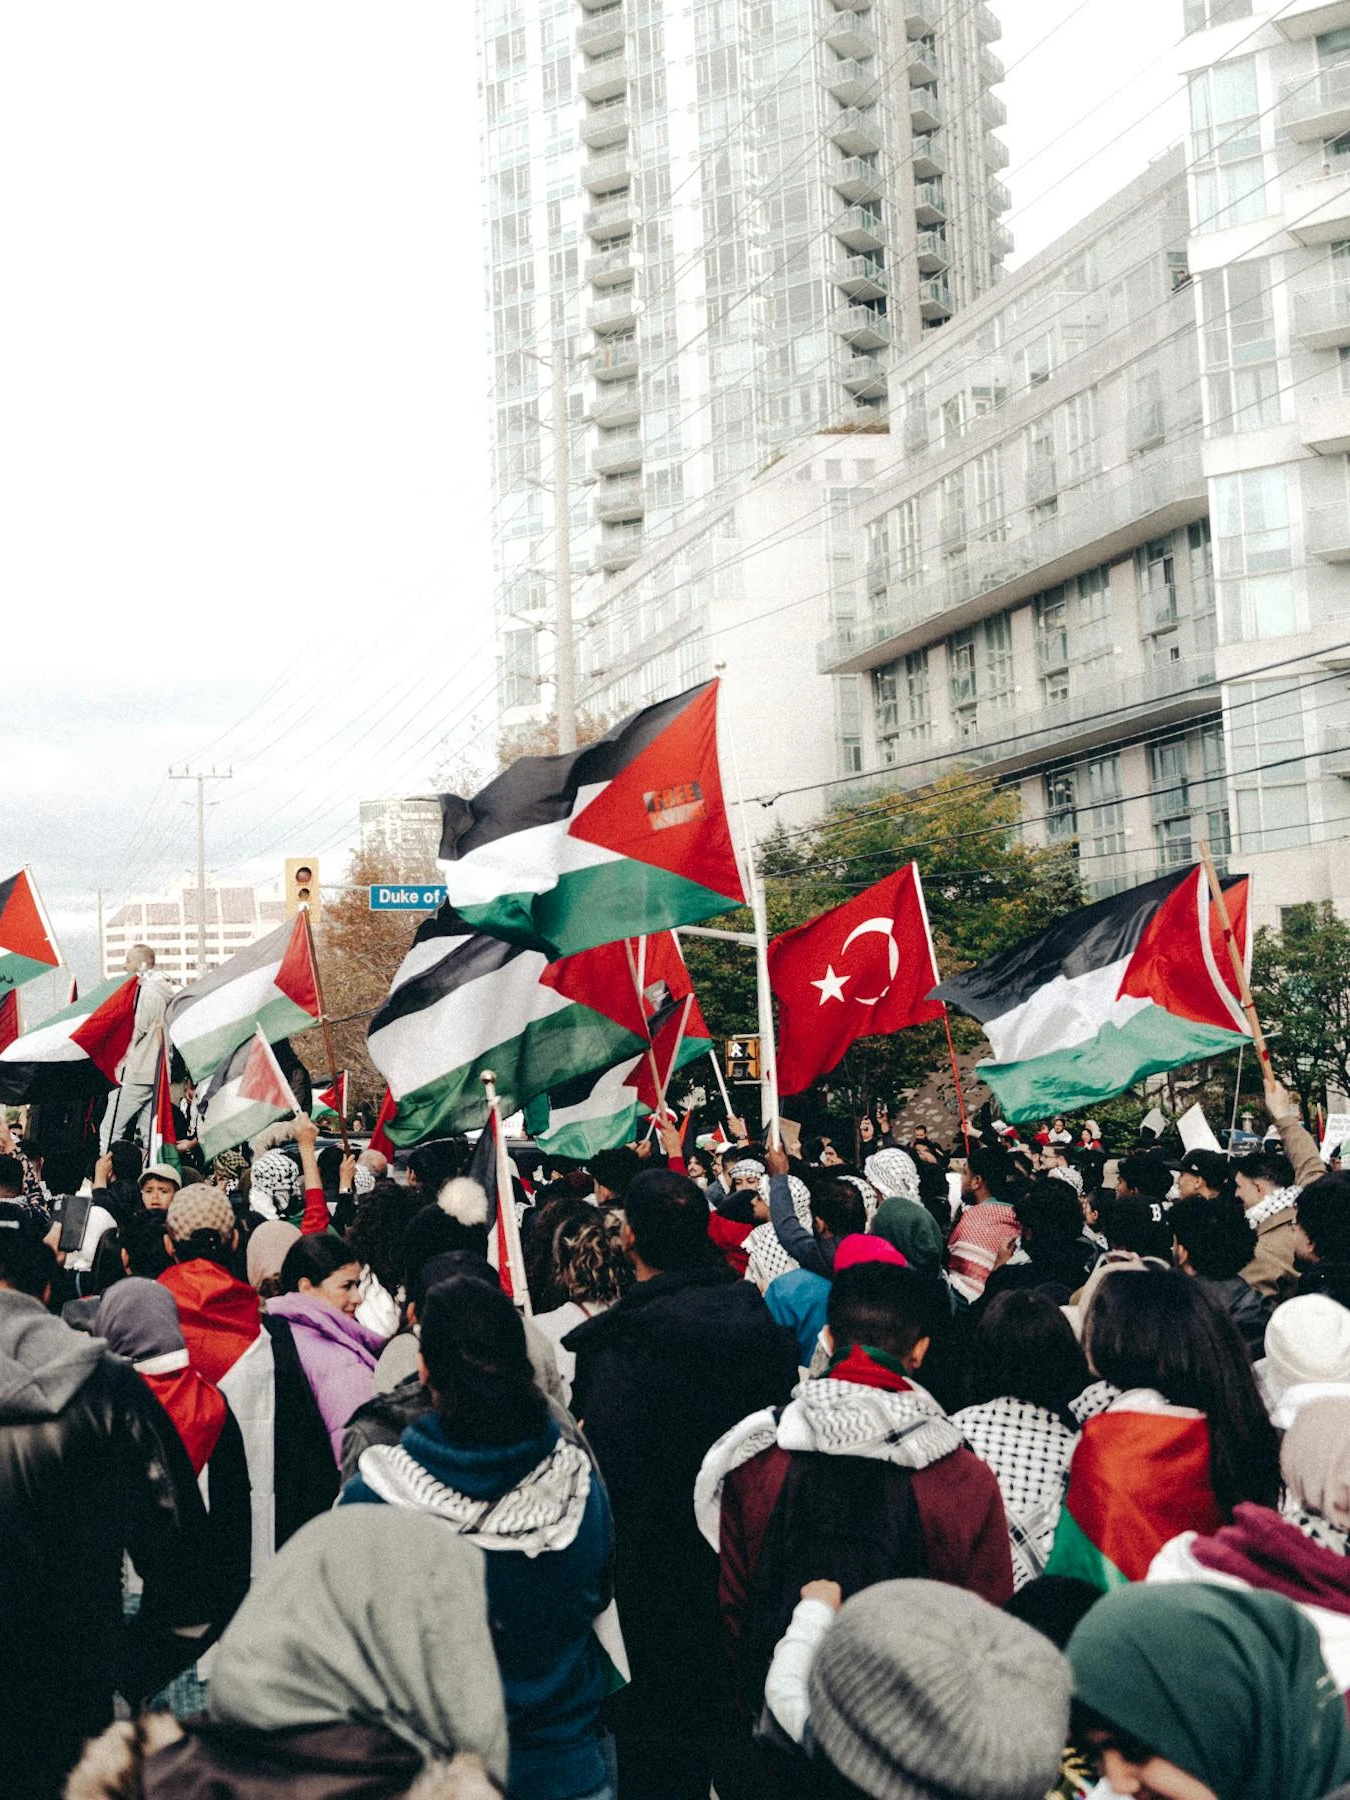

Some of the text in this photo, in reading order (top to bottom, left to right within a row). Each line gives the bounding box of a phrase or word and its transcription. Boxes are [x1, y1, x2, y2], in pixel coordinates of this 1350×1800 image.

[379, 888, 419, 903] Duke
[423, 888, 440, 903] of
[1149, 1203, 1162, 1222] B
